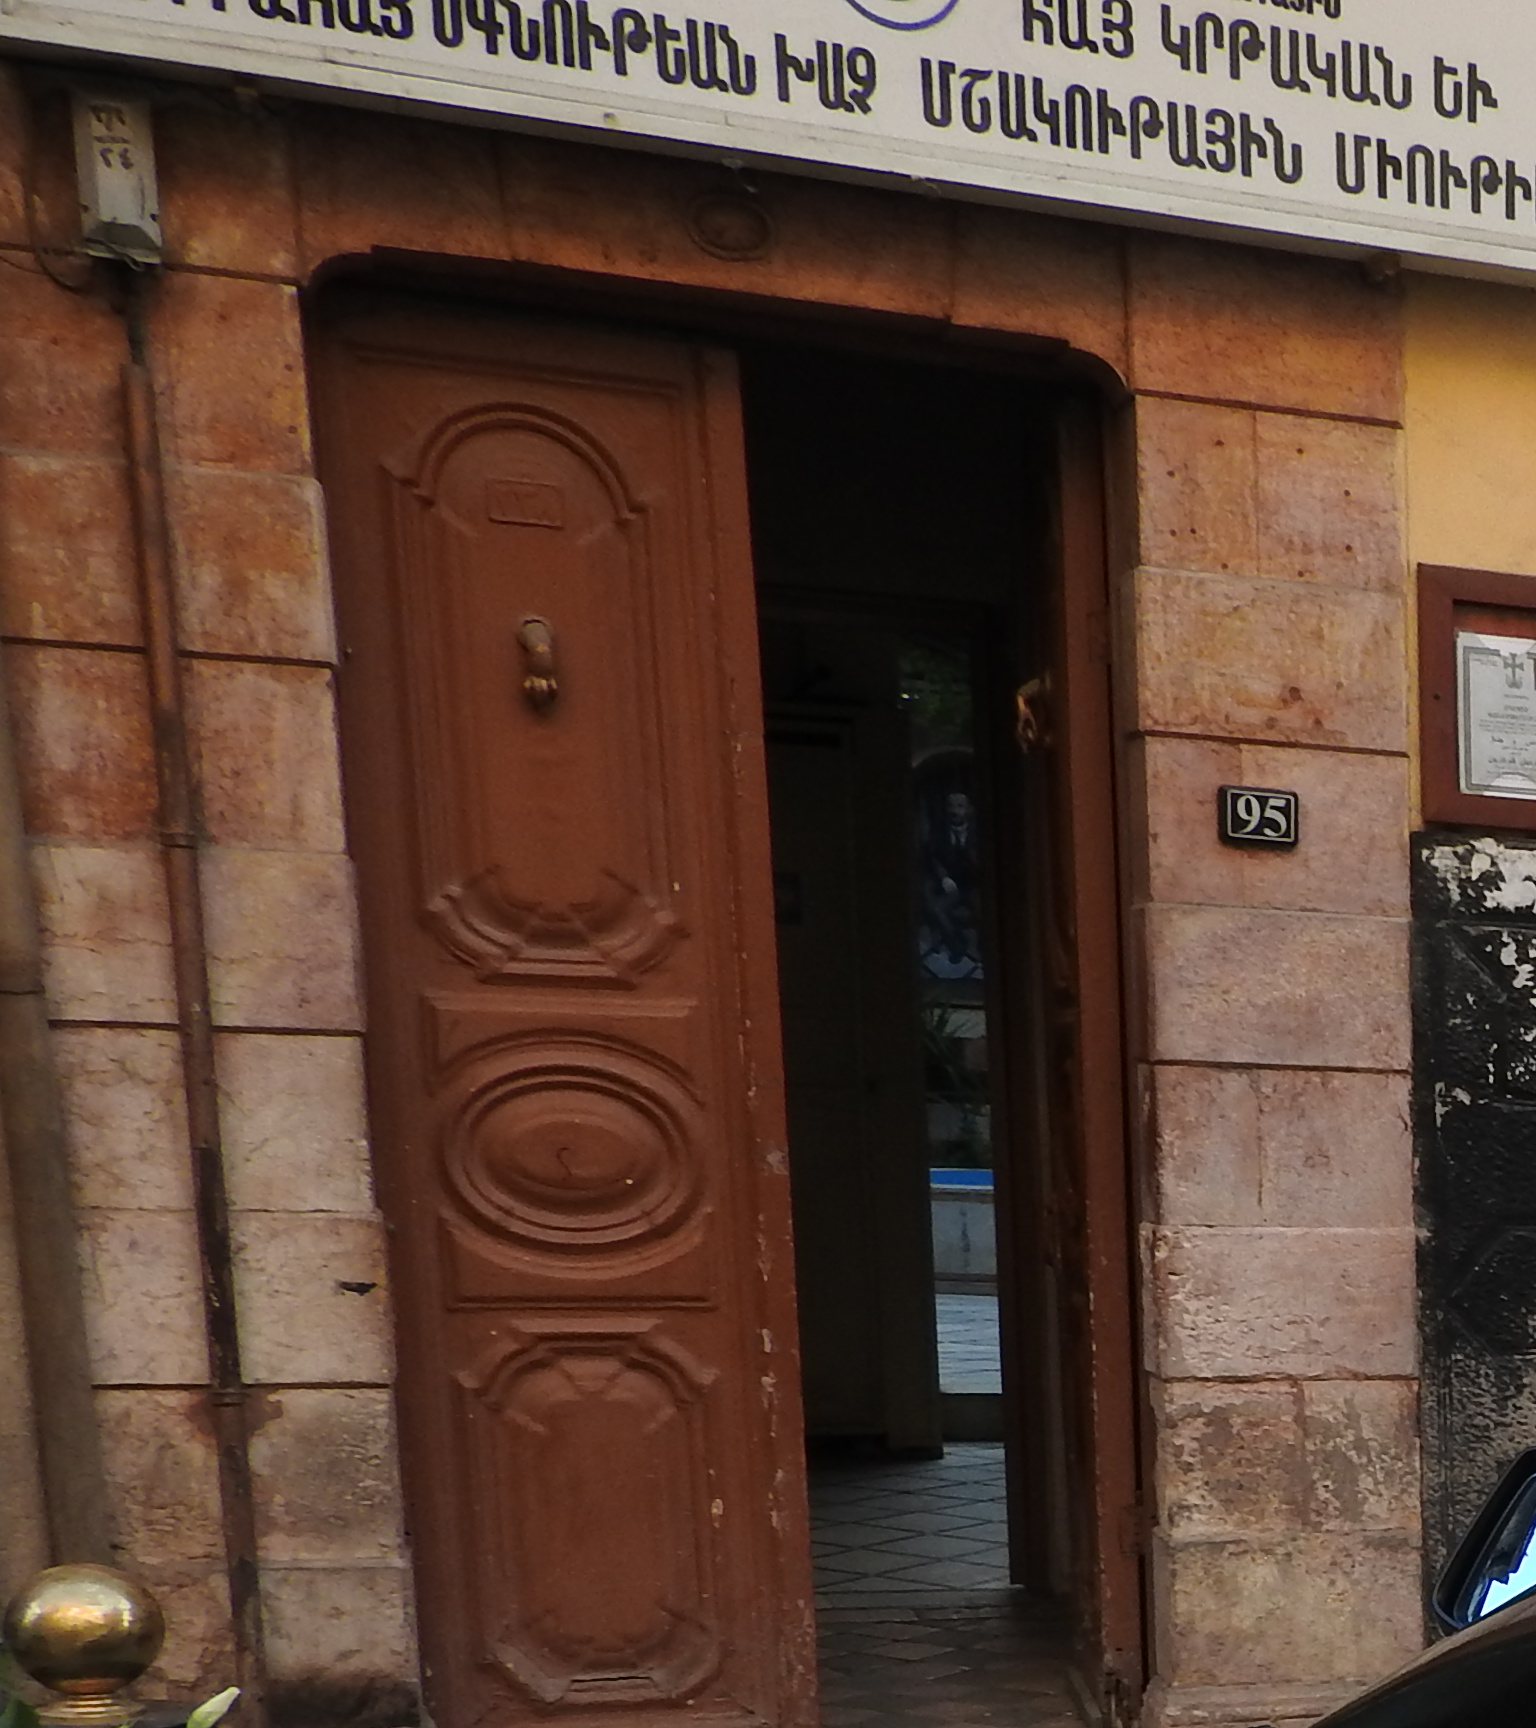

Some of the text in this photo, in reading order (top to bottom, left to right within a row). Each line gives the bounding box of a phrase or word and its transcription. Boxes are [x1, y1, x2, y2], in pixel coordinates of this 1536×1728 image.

[1160, 4, 1413, 110] ԿՐԹԱԿԱՆ
[920, 57, 1303, 184] ՄՇԱԿՈՒԹԱՅԻՆ
[1237, 795, 1287, 837] 95
